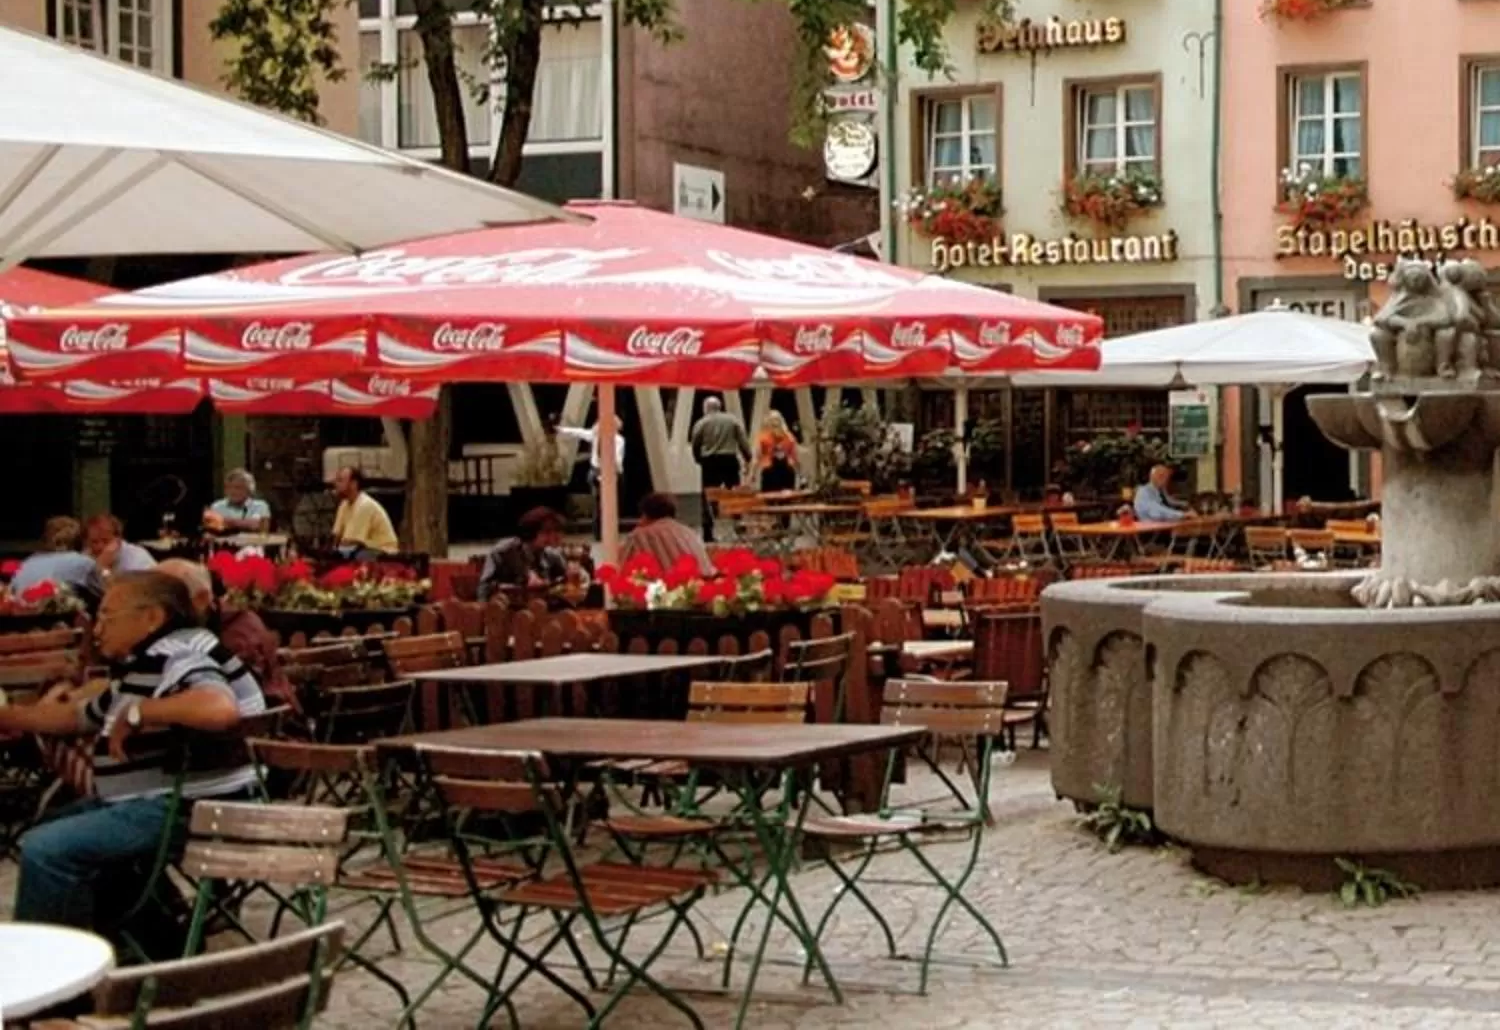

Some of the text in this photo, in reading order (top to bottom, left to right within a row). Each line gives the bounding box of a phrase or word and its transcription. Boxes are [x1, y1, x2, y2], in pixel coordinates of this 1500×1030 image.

[931, 232, 1177, 271] Hotel-Restaurant
[60, 323, 131, 352] Coca-Cola
[241, 321, 313, 350] Coca-Cola
[432, 322, 507, 351] Coca-Cola
[626, 325, 705, 356] Coca-Cola
